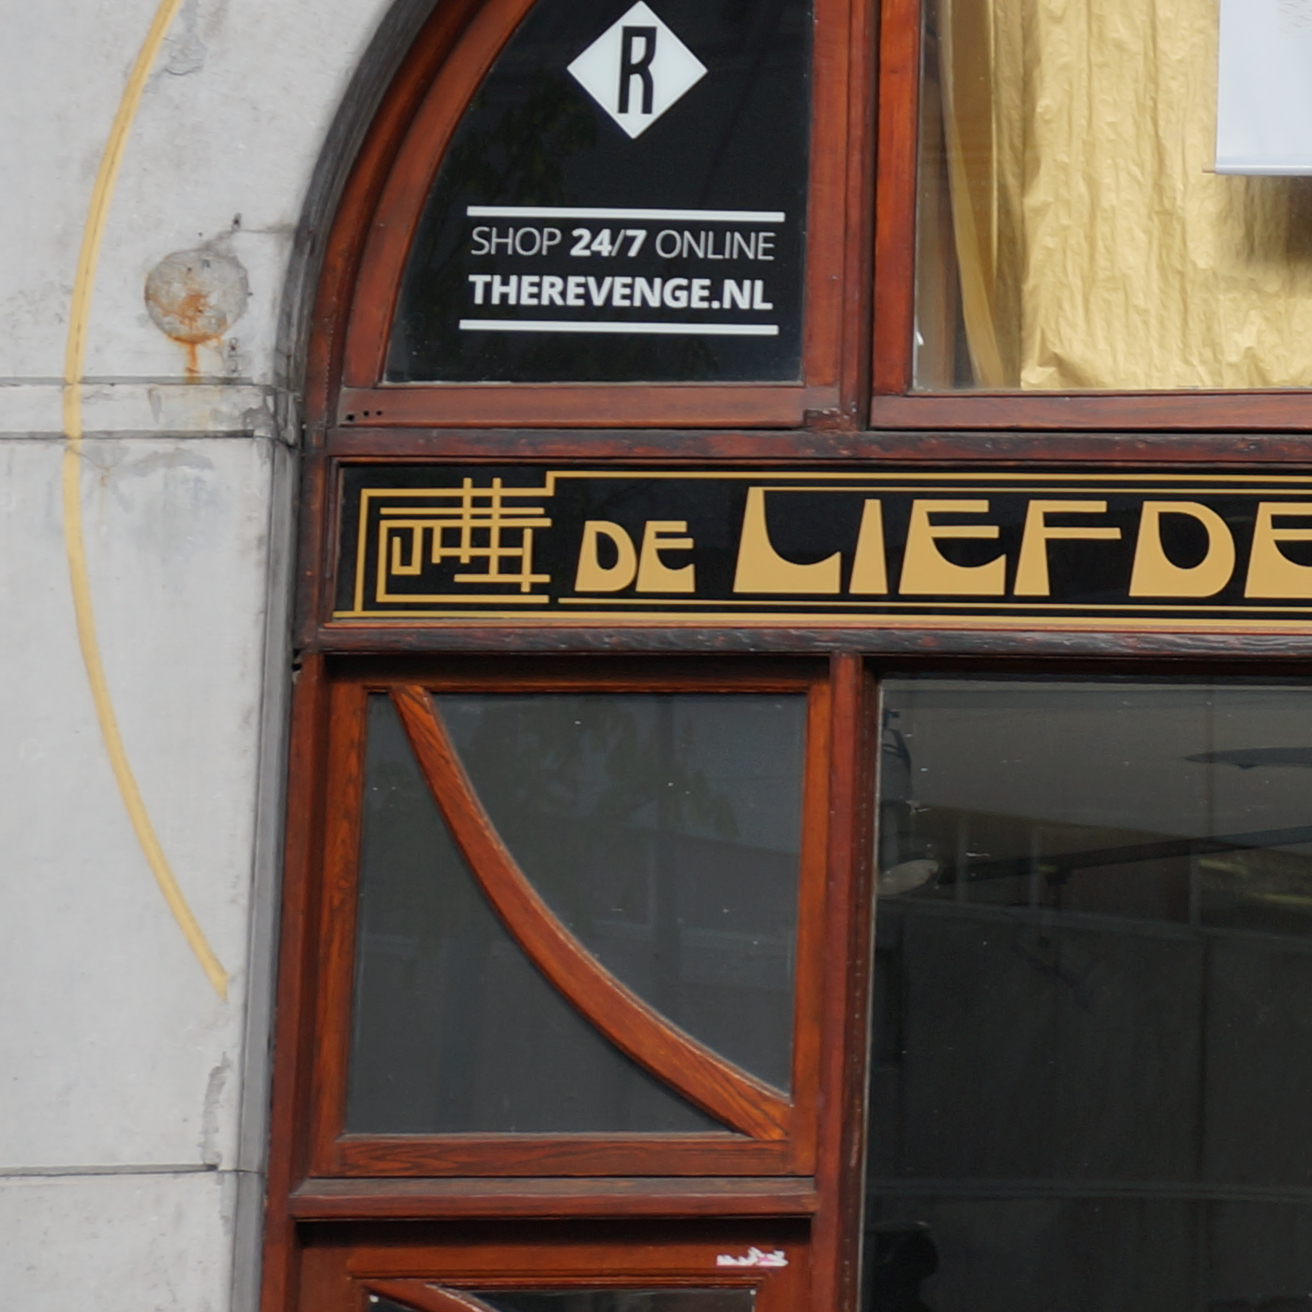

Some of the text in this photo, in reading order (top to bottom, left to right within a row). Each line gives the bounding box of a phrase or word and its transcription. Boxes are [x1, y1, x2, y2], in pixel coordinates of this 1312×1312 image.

[617, 25, 658, 115] R
[471, 226, 776, 261] SHOP 24/7 ONLINE
[467, 274, 774, 311] THEREVENGE.NL
[573, 519, 696, 594] DE
